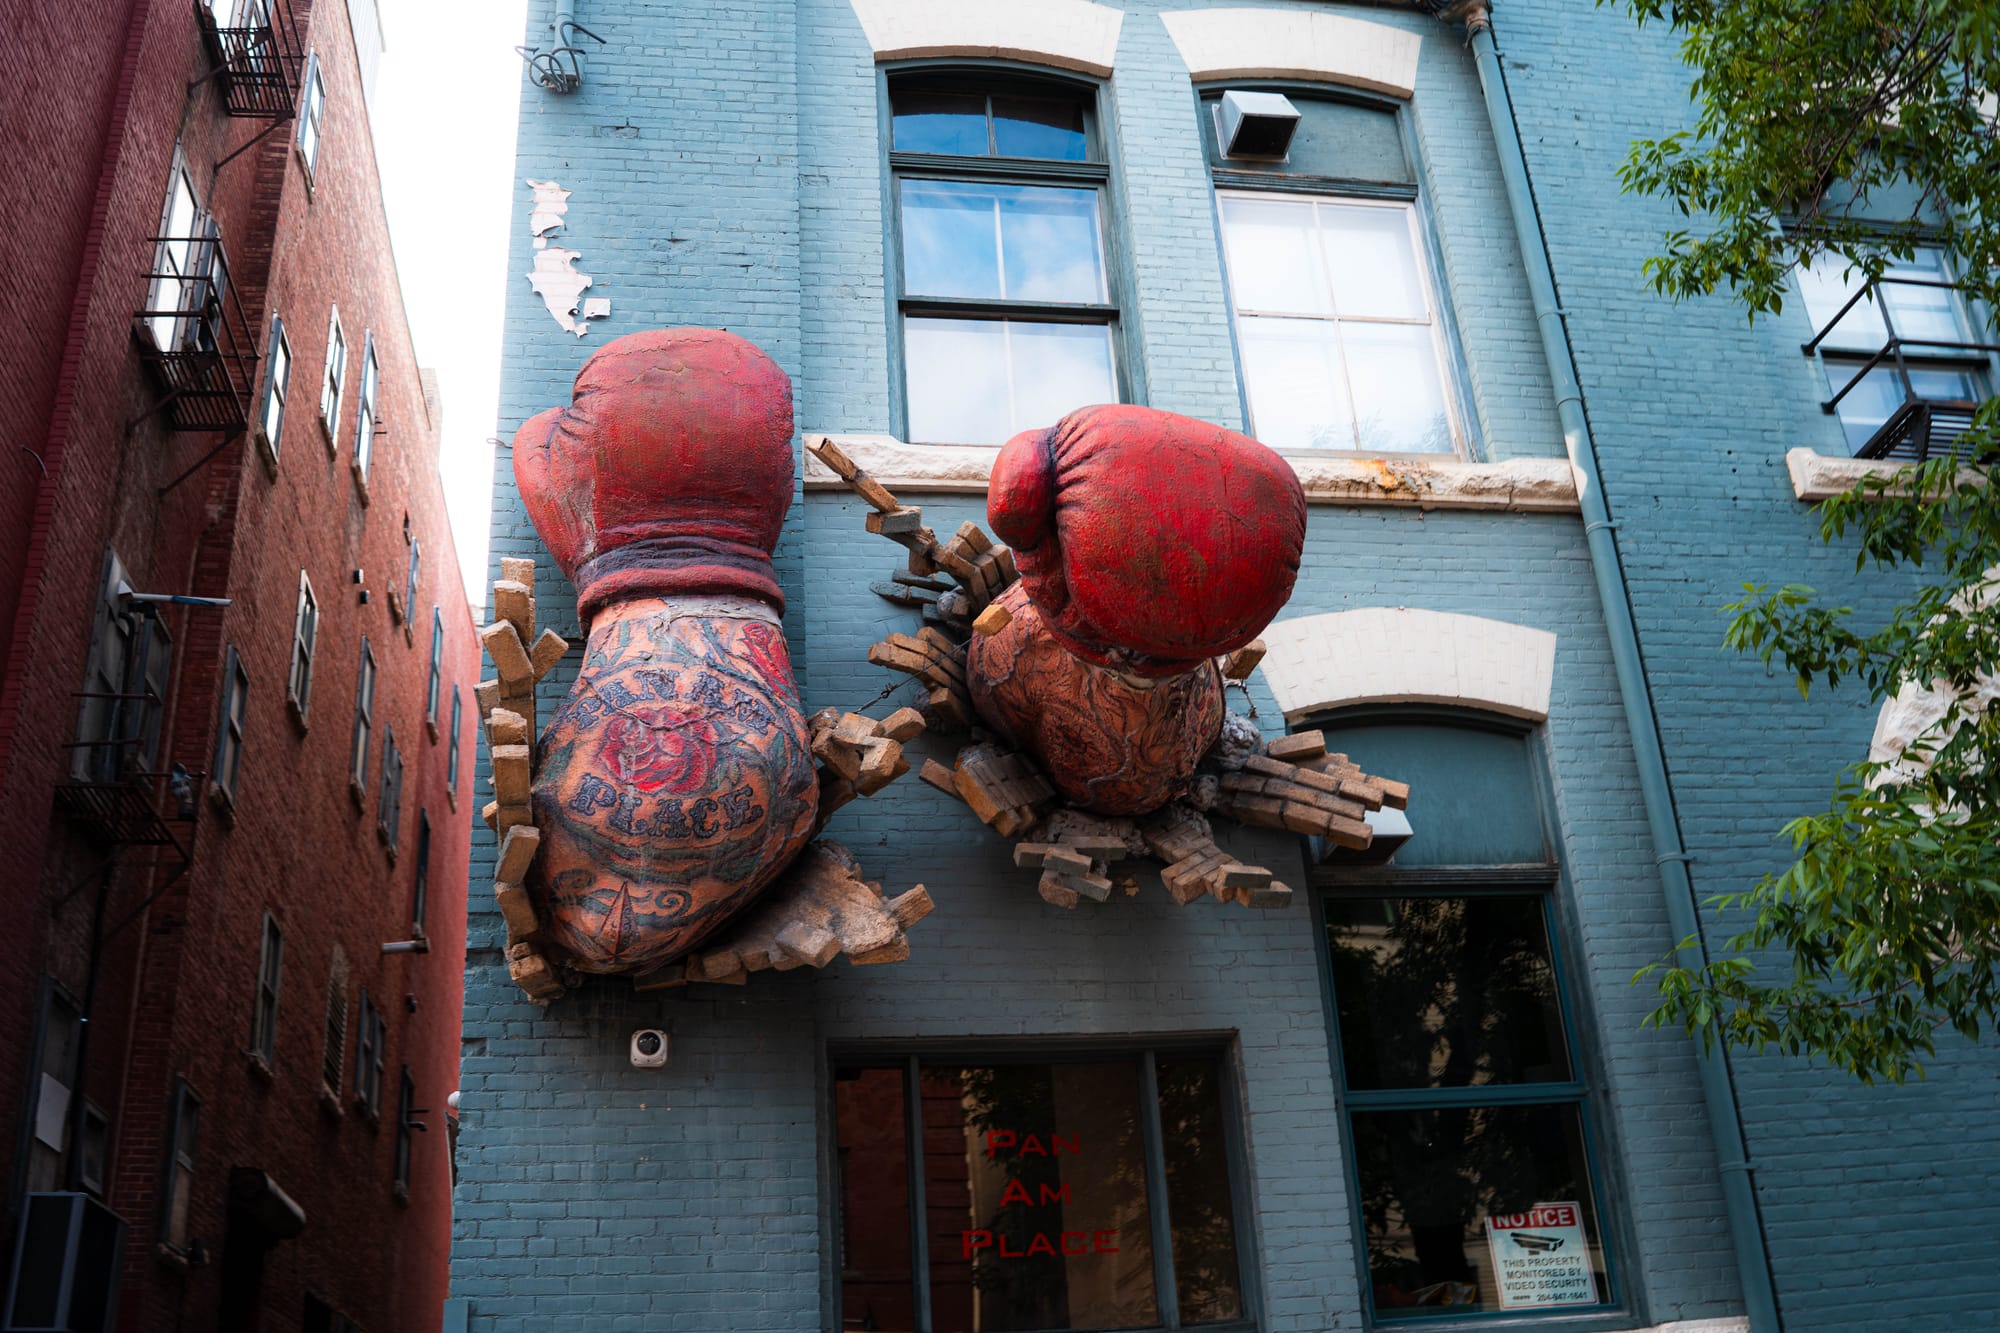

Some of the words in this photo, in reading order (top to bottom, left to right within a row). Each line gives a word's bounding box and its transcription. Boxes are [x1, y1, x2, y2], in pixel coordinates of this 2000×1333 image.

[567, 670, 680, 730] PAN
[685, 671, 776, 735] AM
[569, 772, 764, 839] PLACE
[986, 1129, 1081, 1159] PAN
[1000, 1178, 1073, 1207] AM
[1496, 1209, 1572, 1228] NOTICE
[961, 1229, 1120, 1260] PLACE
[1503, 1259, 1526, 1268] THIS
[1528, 1256, 1581, 1268] PROPERTY
[1506, 1268, 1566, 1279] MONITORED
[1568, 1267, 1582, 1276] BY
[1504, 1280, 1536, 1290] VIDEO
[1538, 1278, 1588, 1289] SECURITY
